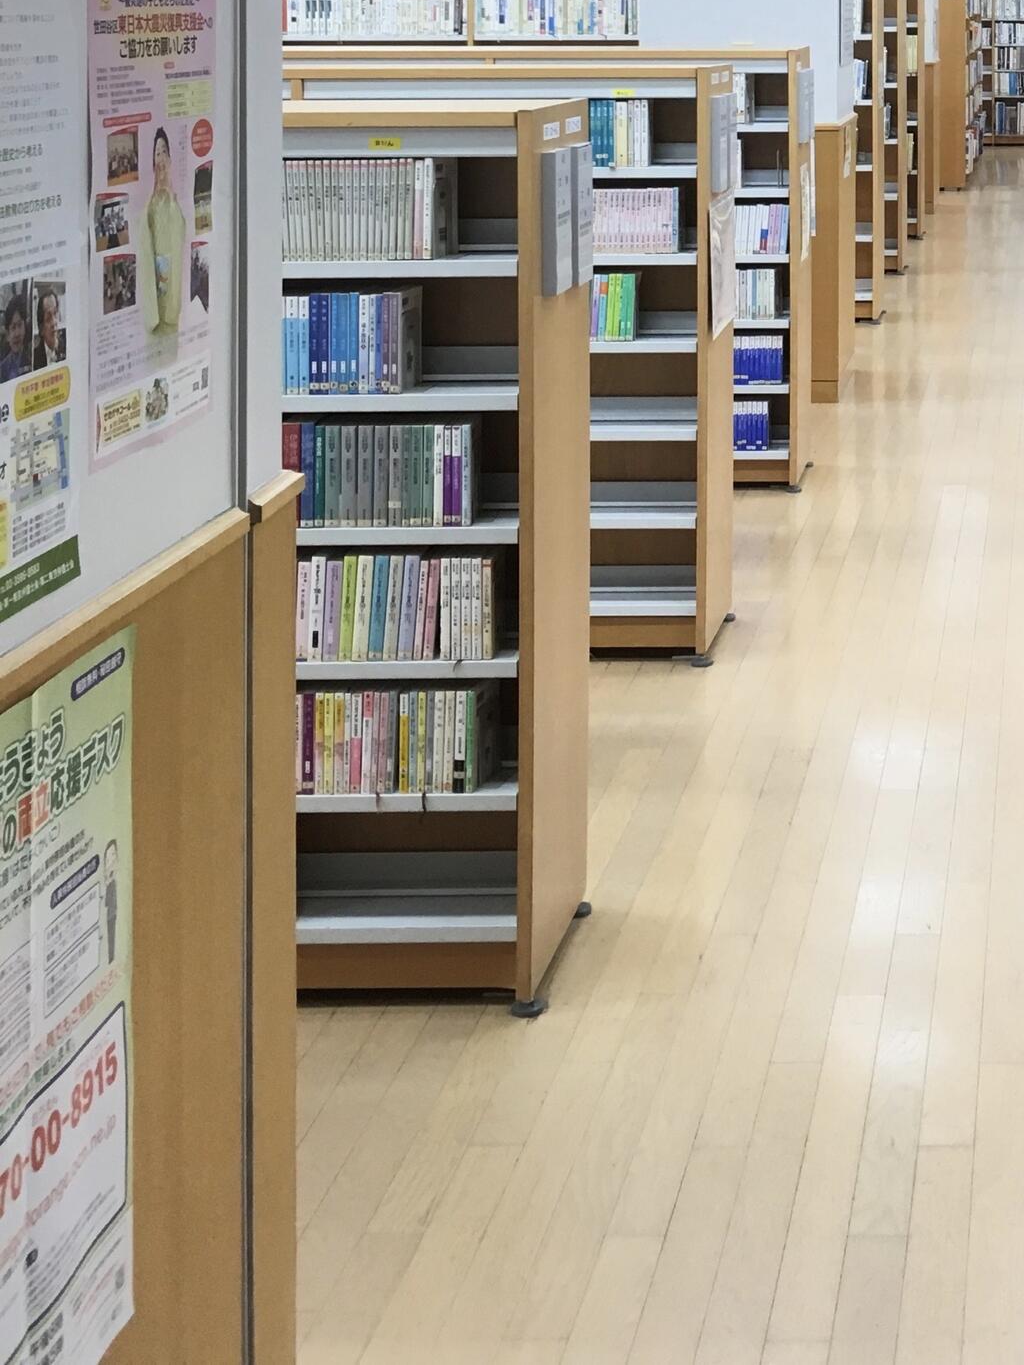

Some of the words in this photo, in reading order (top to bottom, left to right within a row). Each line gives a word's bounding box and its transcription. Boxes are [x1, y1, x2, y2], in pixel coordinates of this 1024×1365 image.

[119, 35, 198, 59] ご協力をお願いします
